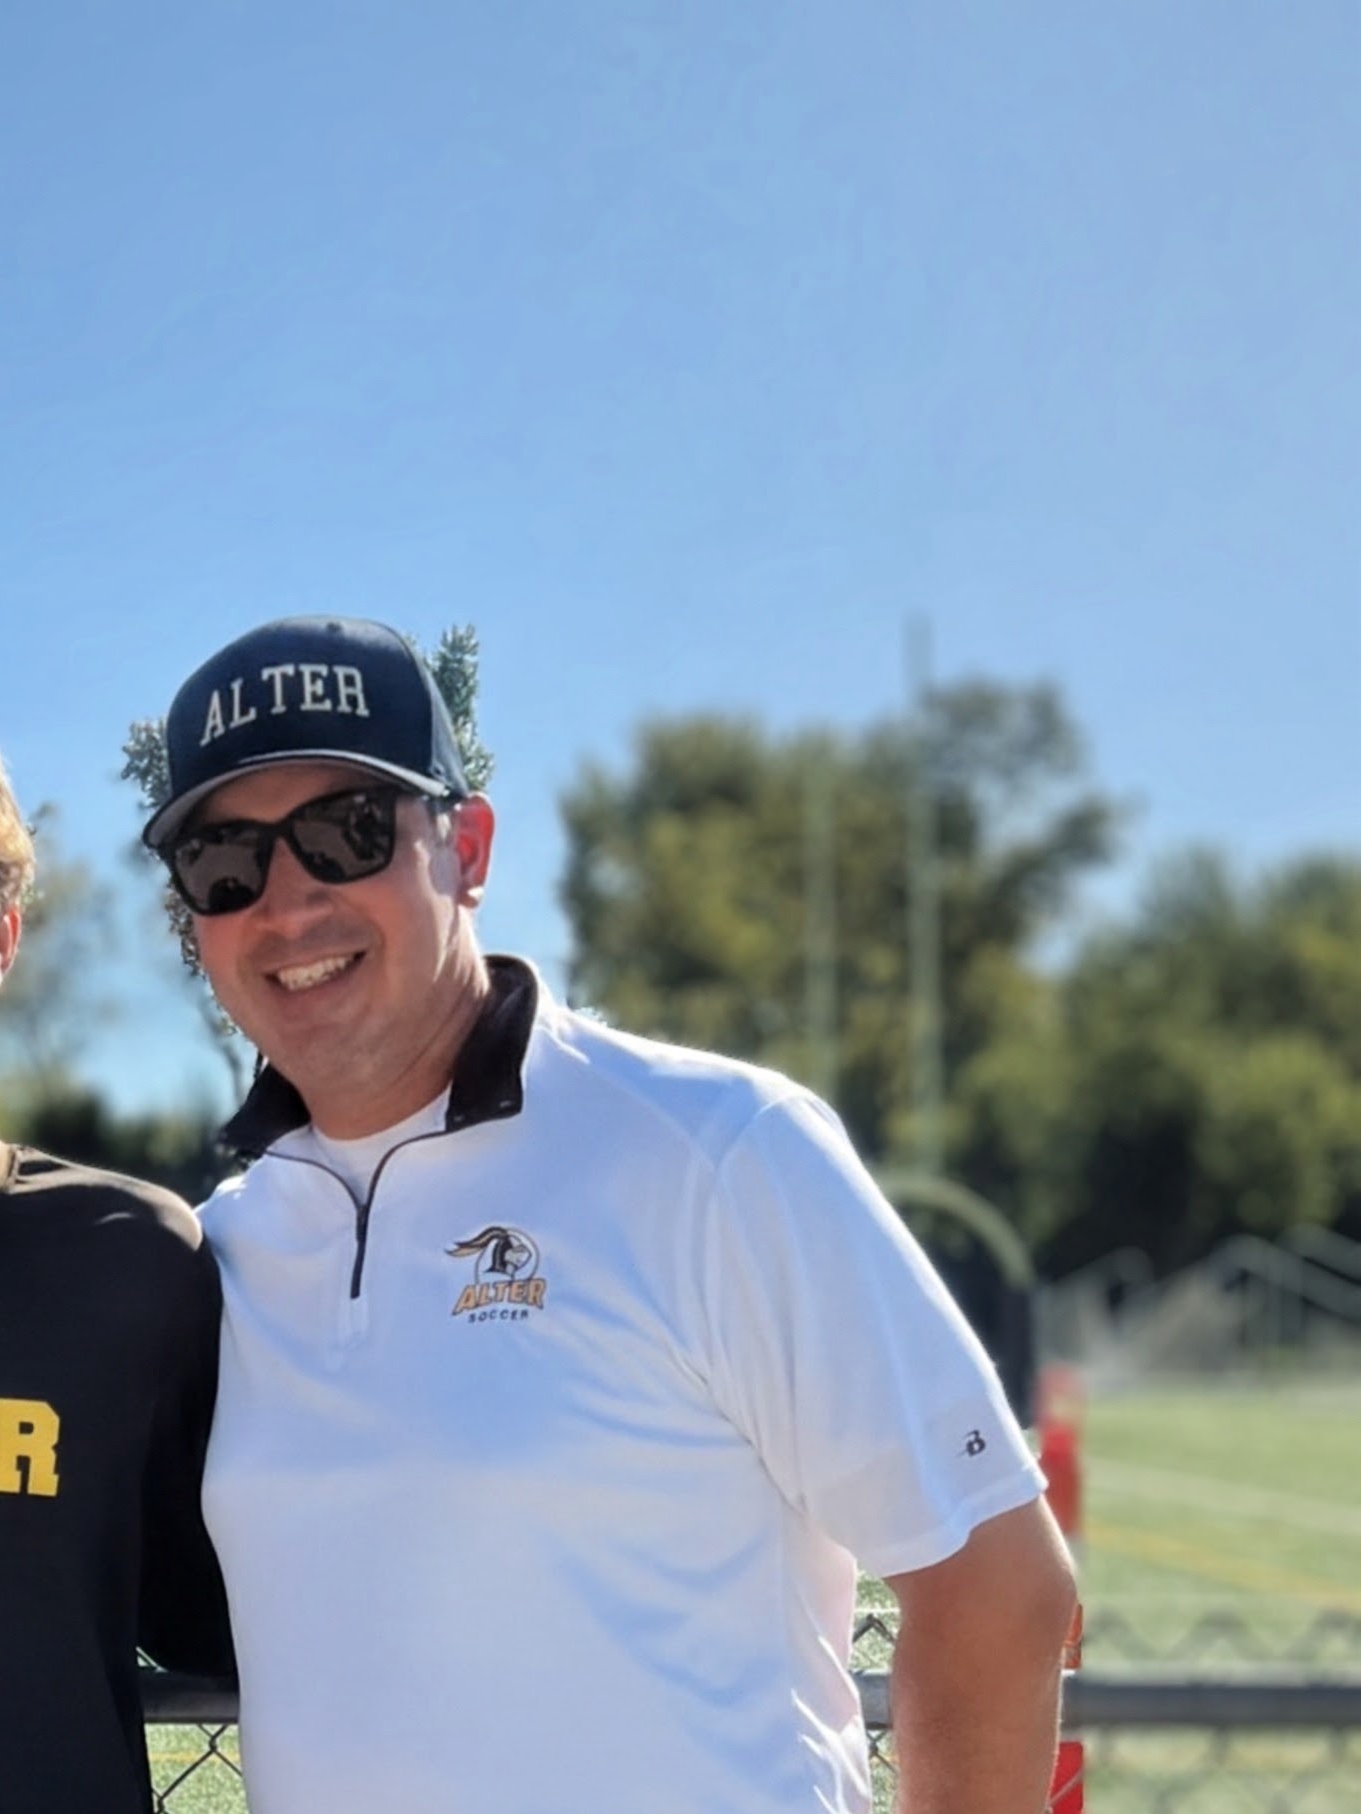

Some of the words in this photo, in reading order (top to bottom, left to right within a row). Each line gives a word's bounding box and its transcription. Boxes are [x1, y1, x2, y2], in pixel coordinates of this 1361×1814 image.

[199, 663, 371, 747] ALTER
[450, 1277, 547, 1317] ALTER
[468, 1309, 530, 1324] SOCCER
